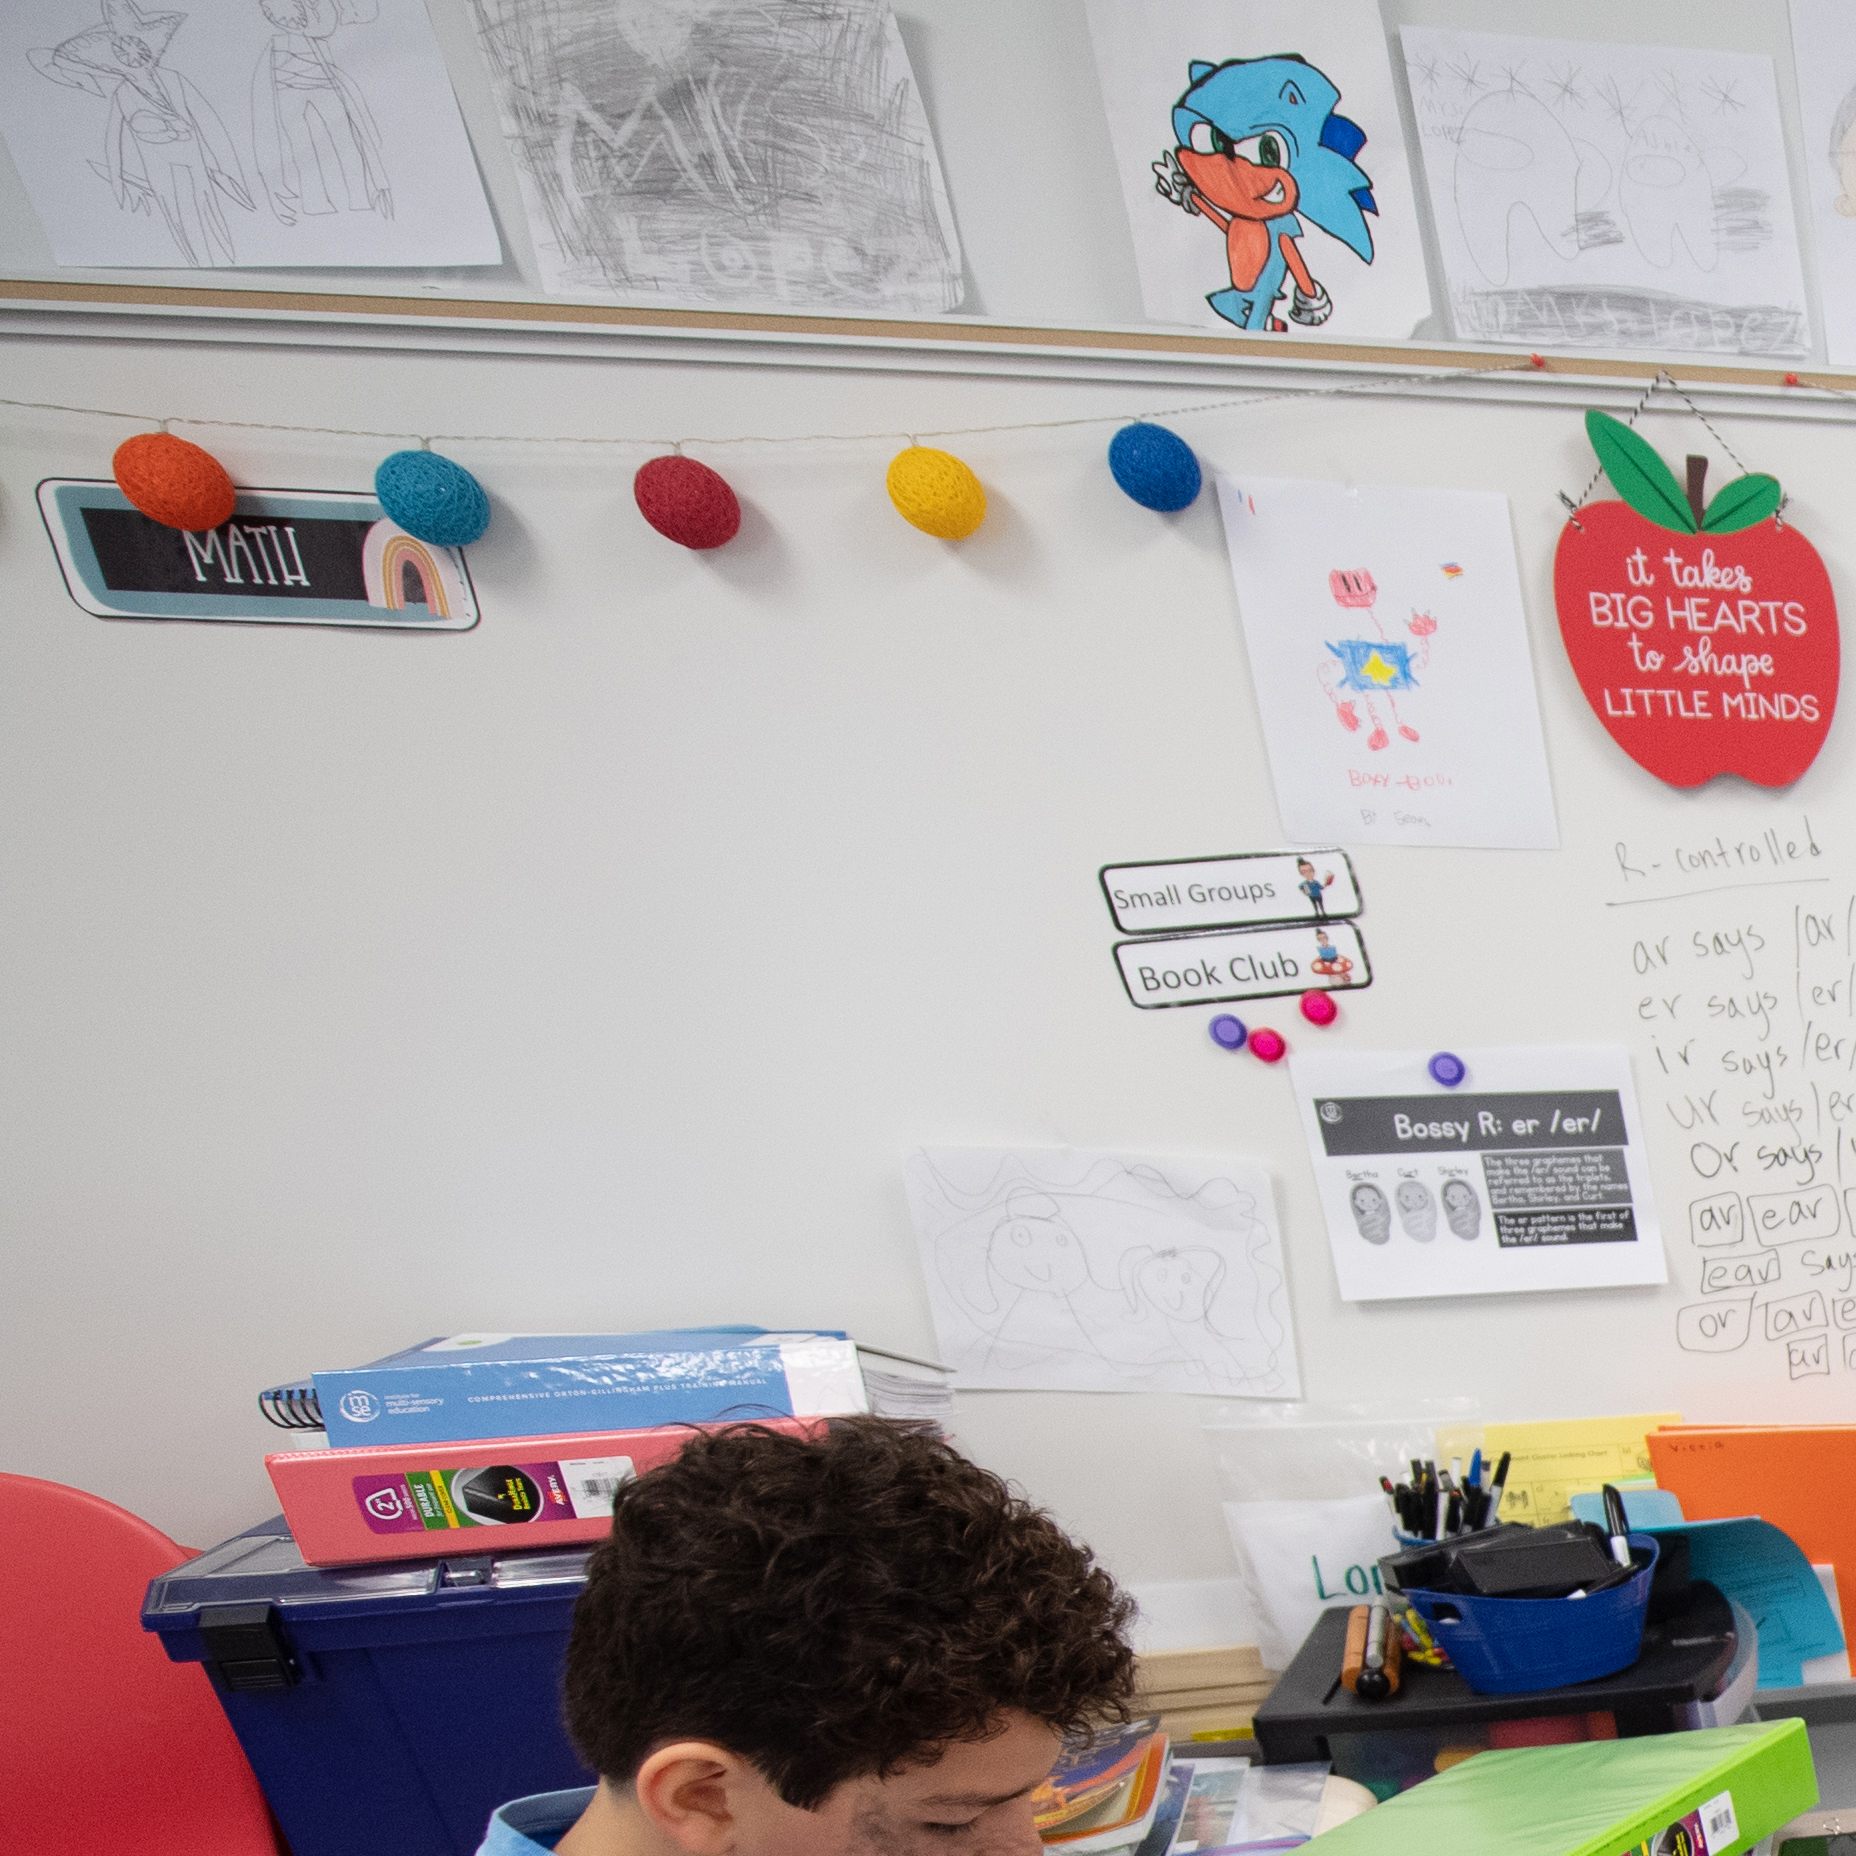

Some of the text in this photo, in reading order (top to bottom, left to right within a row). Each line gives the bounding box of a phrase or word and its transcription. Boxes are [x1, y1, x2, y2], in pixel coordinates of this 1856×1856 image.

[184, 526, 309, 588] MATH
[1626, 547, 1752, 593] it takes
[1589, 592, 1807, 635] BIG HEARTS
[1627, 632, 1774, 690] to shape
[1604, 688, 1820, 721] LITTLE MINDS
[1113, 880, 1276, 909] Small Groups
[1137, 951, 1300, 992] Book Club
[1633, 935, 1671, 976] ar
[1692, 924, 1766, 981] says
[1638, 993, 1684, 1020] er
[1707, 990, 1778, 1041] says
[1651, 1034, 1697, 1075] ir
[1721, 1045, 1788, 1100] says
[1393, 1108, 1601, 1143] Bossy R: er /er/
[1762, 1197, 1823, 1230] ear
[467, 1391, 551, 1403] COMPREHENSIVE
[553, 1385, 651, 1399] ORTON-GILLINGHAM
[653, 1383, 678, 1391] PLUS
[413, 1483, 435, 1518] DURABLE
